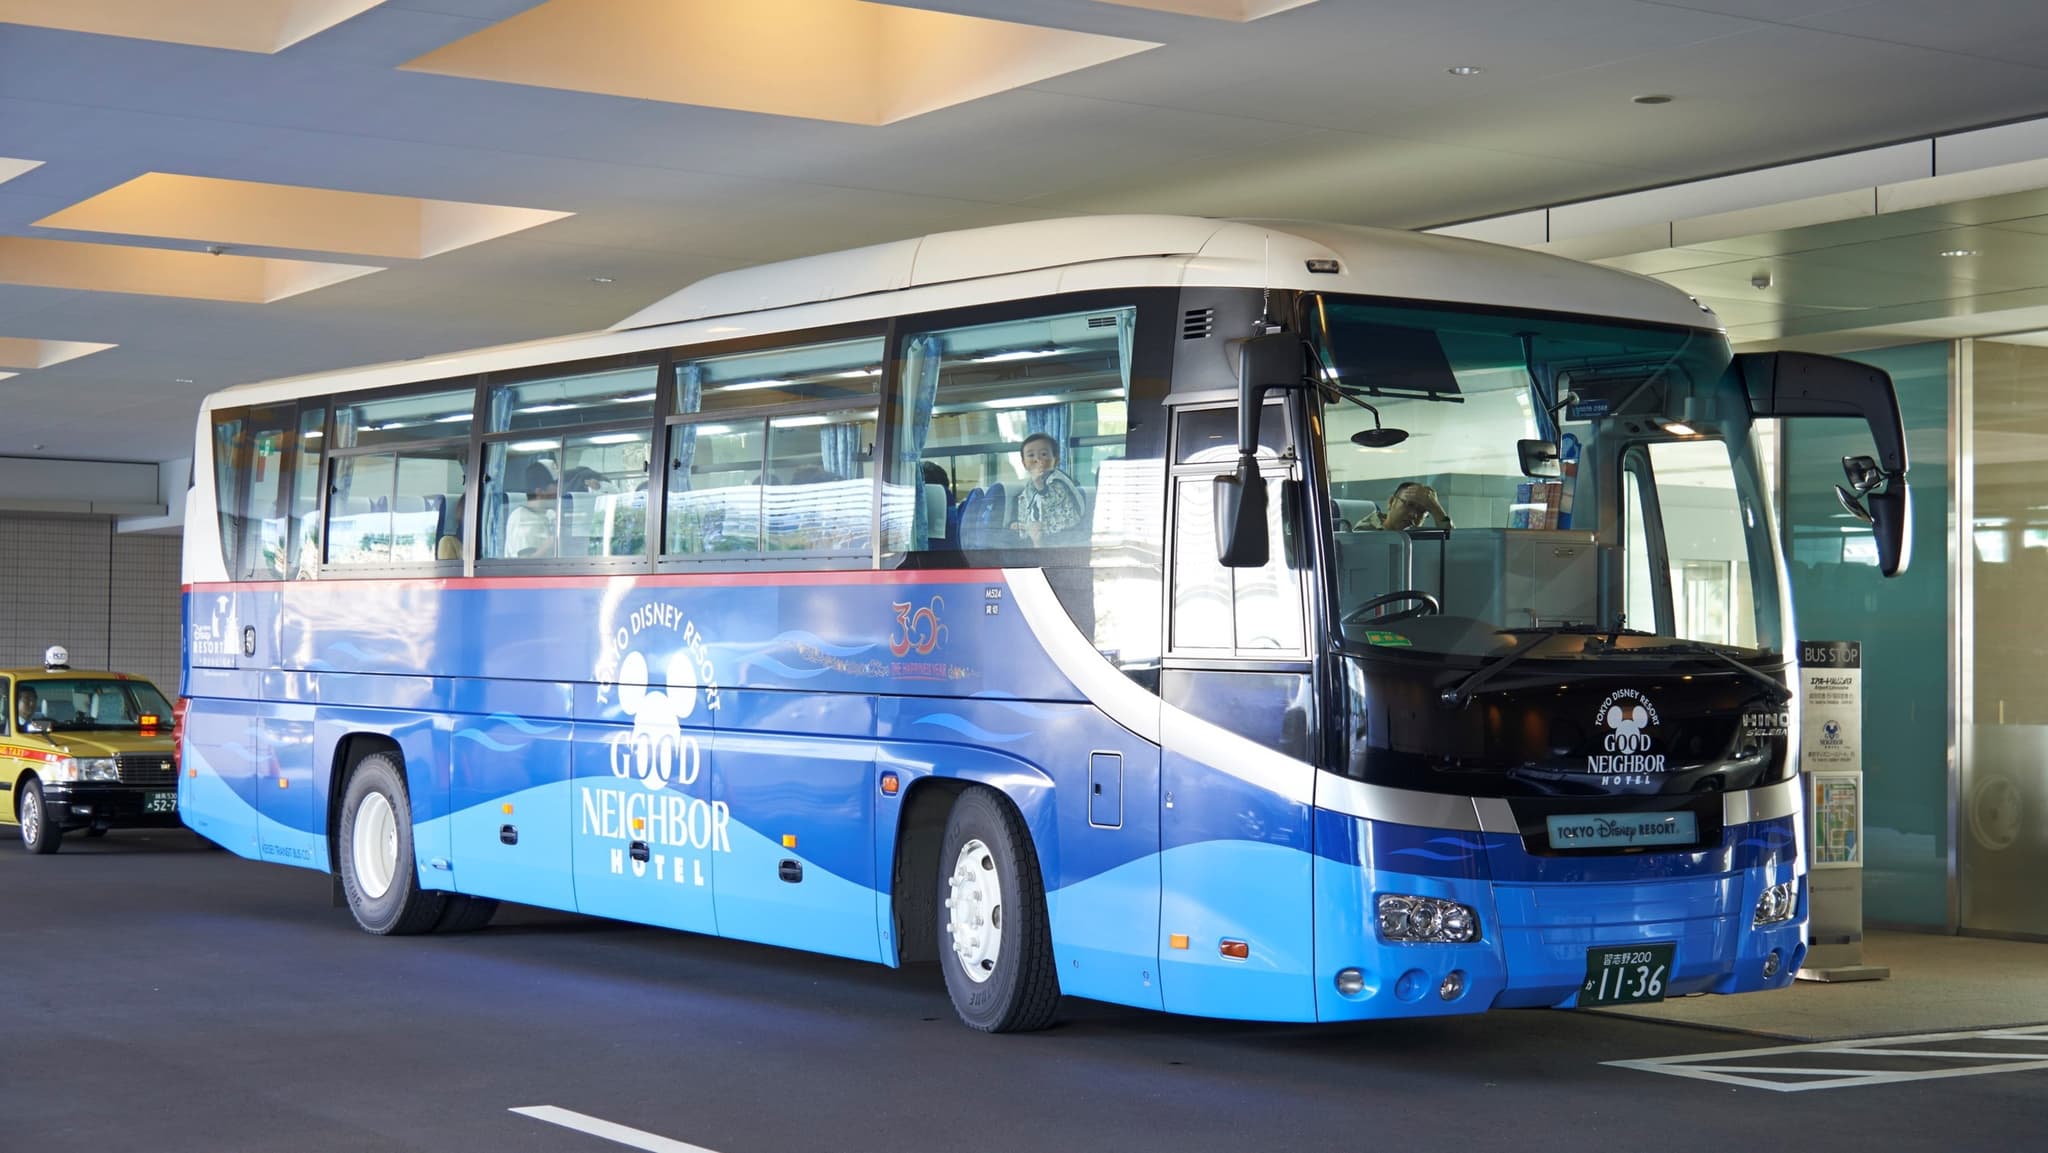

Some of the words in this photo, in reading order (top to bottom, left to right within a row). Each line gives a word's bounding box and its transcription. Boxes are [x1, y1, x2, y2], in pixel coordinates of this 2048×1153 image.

[630, 602, 683, 634] DISNEY
[684, 620, 720, 710] RESORT
[1805, 647, 1826, 662] BUS
[1829, 648, 1858, 662] STOP
[1595, 697, 1612, 726] TOKYO
[1612, 688, 1640, 701] DISNEY
[1640, 695, 1660, 726] RESORT
[1742, 712, 1790, 728] HINO
[1604, 734, 1652, 752] GOOD
[610, 731, 700, 786] GOOD
[1587, 754, 1665, 774] NEIGHBOR
[1601, 775, 1651, 786] HOTEL
[581, 787, 731, 853] NEIGHBOR
[1557, 825, 1594, 839] TOKYO
[1593, 818, 1637, 843] Disney
[1639, 822, 1676, 836] RESORT
[610, 848, 705, 886] HOTEL
[1603, 951, 1652, 966] 習志野200
[1598, 964, 1665, 1001] 11-36
